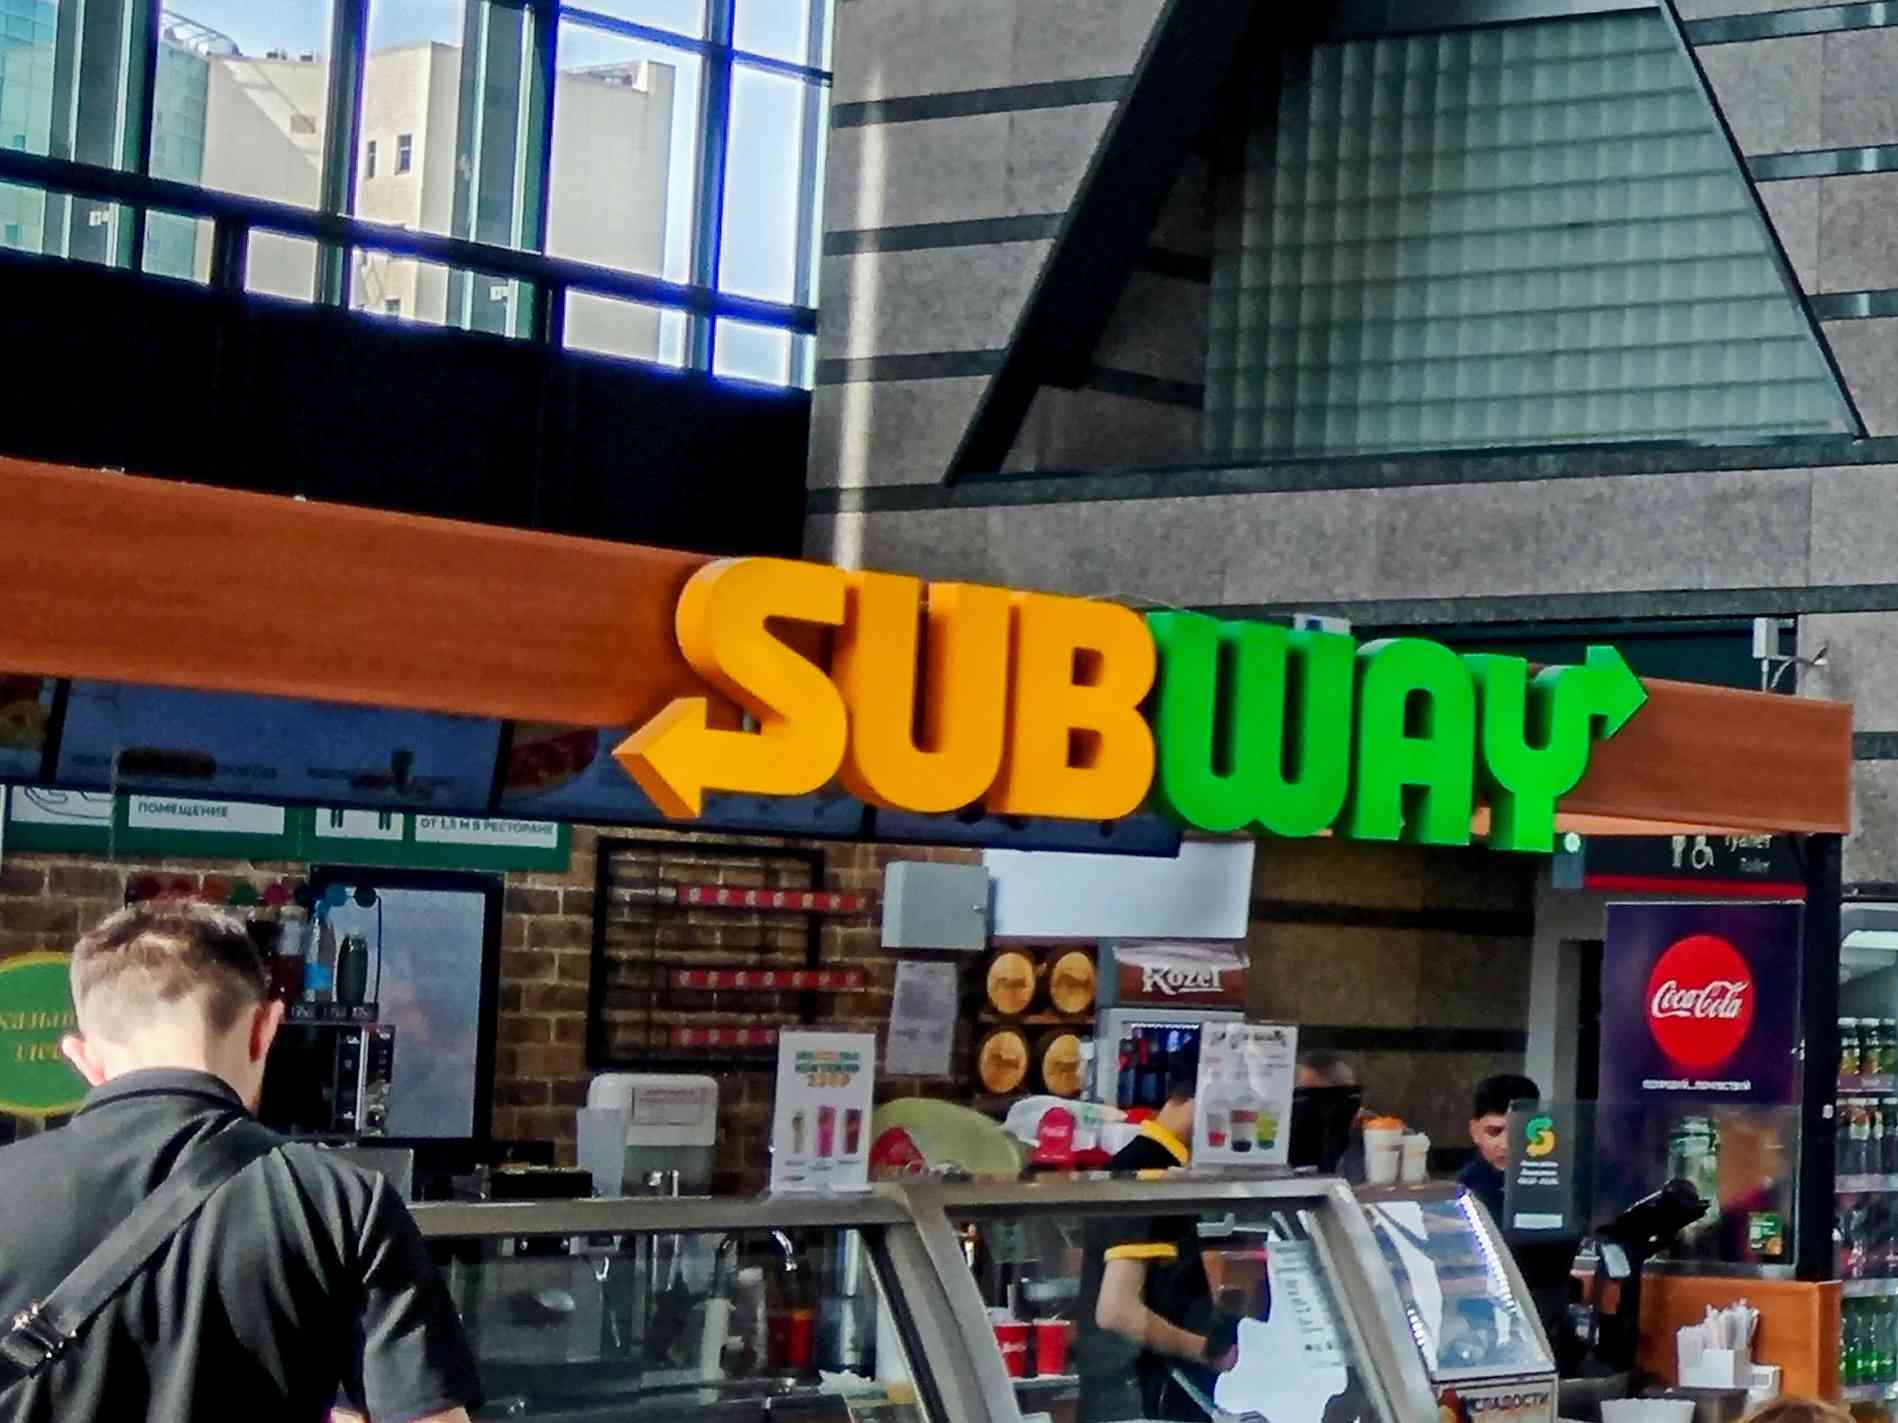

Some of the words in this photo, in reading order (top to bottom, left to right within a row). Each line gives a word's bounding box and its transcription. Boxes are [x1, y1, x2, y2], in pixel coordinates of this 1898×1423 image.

[612, 556, 1648, 853] SUBWAY
[138, 801, 228, 818] ПОМЕЩЕНИЕ
[1142, 966, 1225, 995] Kozel
